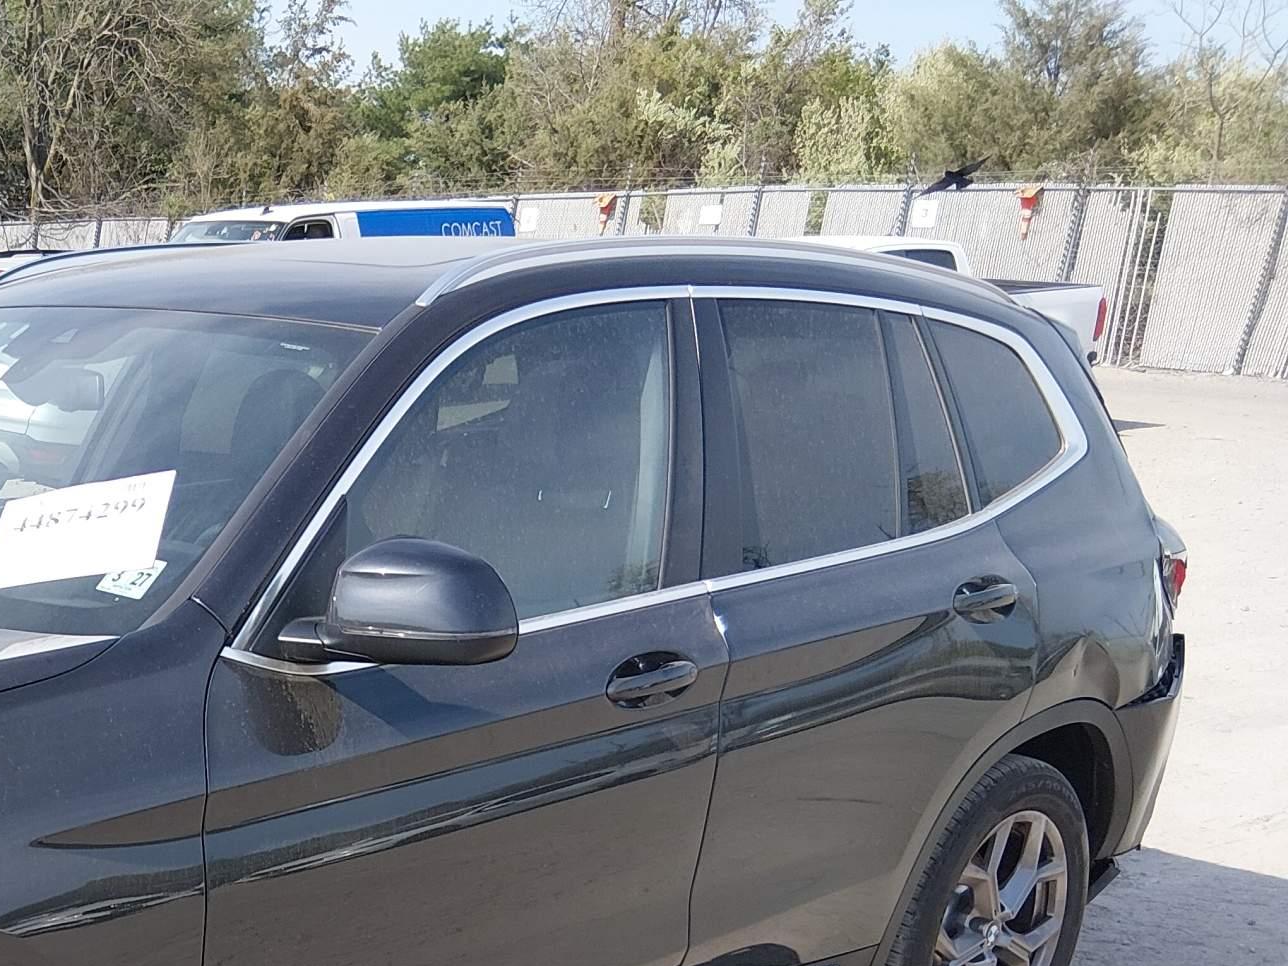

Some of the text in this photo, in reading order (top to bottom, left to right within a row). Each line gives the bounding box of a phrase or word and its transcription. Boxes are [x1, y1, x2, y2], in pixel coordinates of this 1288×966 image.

[441, 221, 502, 236] COMCAST
[13, 498, 146, 533] 44874299
[130, 571, 152, 587] 27
